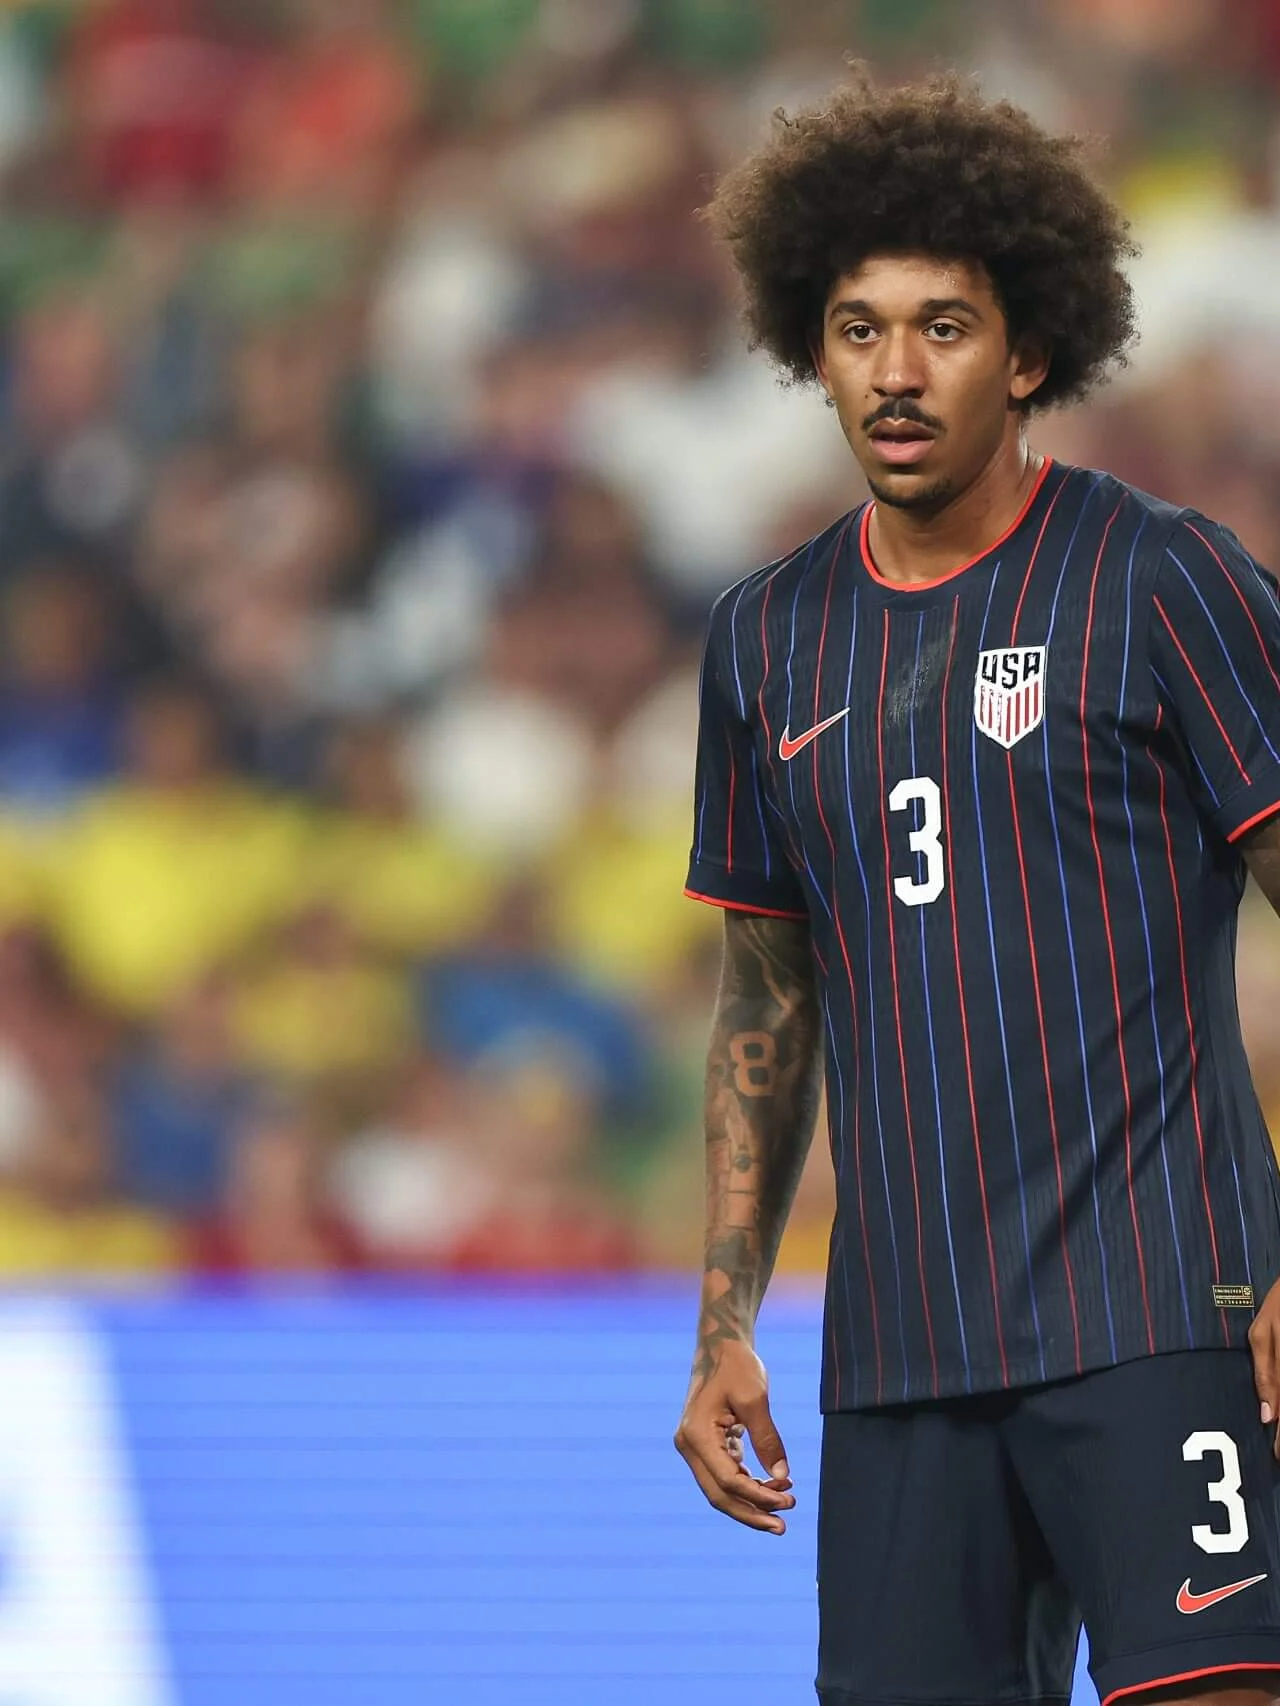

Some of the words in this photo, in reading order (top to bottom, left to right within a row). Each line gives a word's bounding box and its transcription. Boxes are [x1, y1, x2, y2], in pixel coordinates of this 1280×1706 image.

[981, 651, 1041, 690] USA
[888, 776, 945, 907] 3
[729, 1030, 777, 1097] 8
[1182, 1431, 1250, 1554] 3
